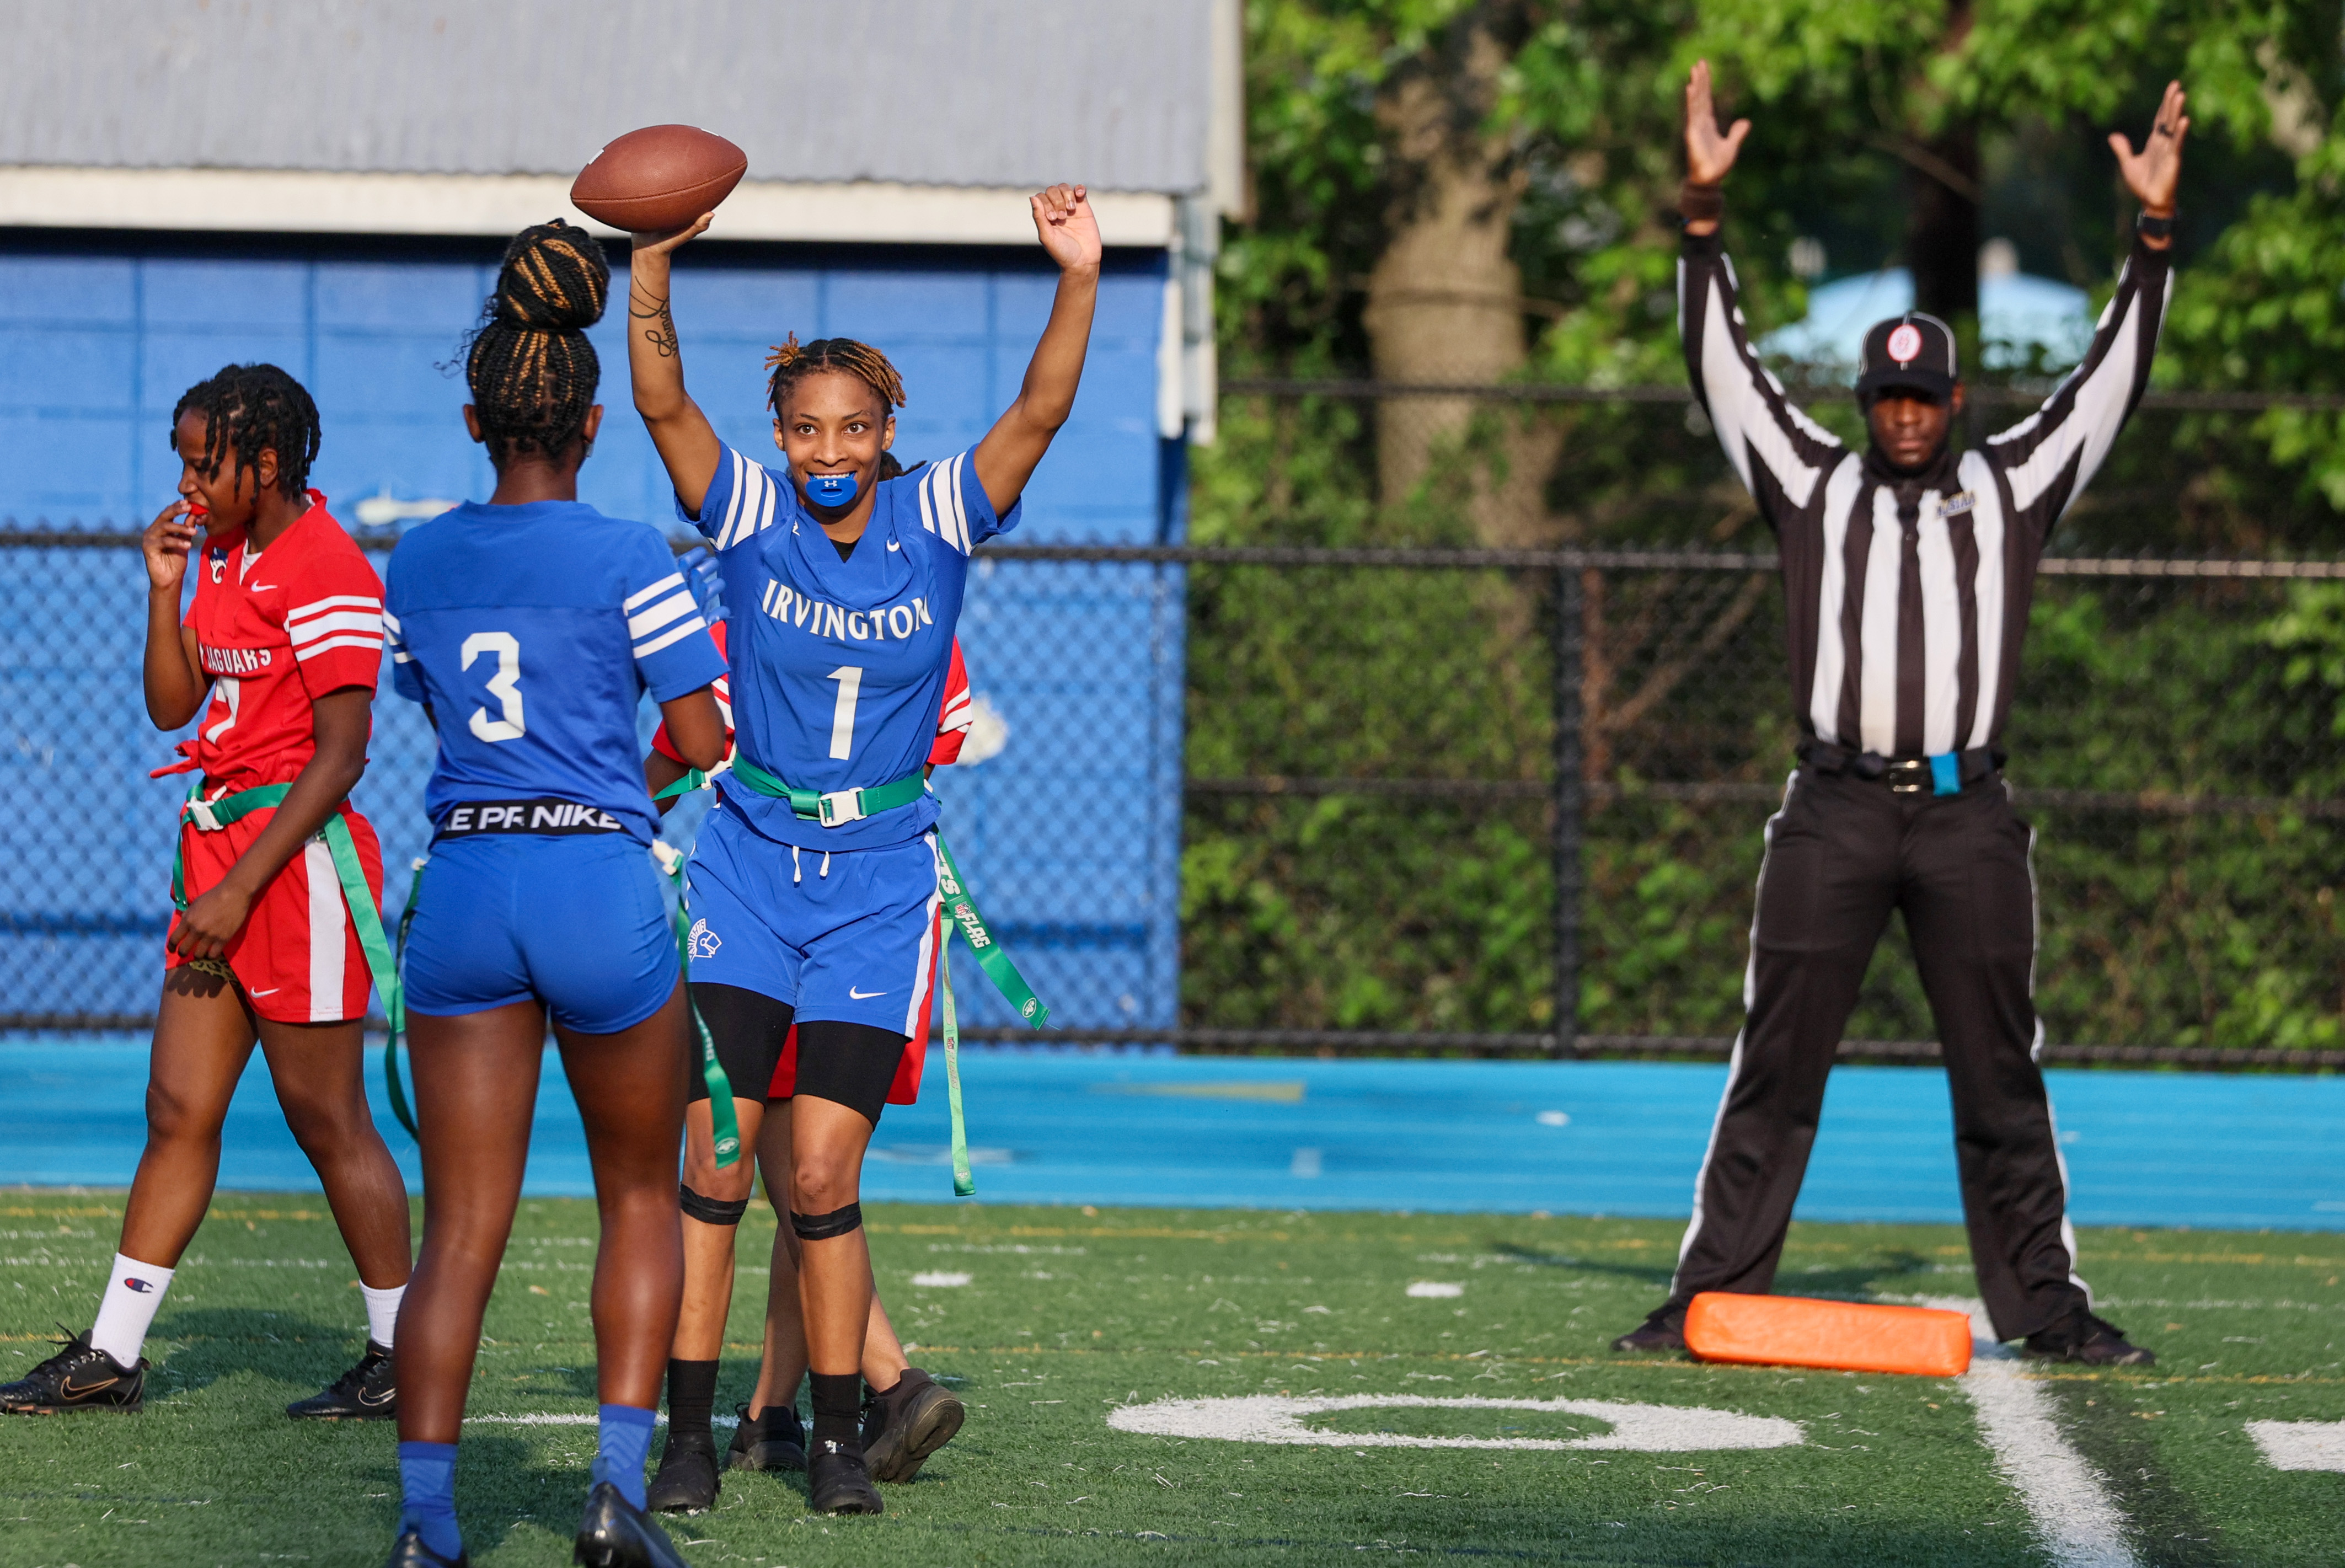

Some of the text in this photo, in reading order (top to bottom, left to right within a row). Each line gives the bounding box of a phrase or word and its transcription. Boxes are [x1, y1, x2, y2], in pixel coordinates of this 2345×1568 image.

[762, 577, 933, 641] IRVINGTON
[206, 645, 272, 674] JAGUARS
[461, 631, 526, 743] 3
[206, 676, 240, 745] 7
[827, 665, 863, 761] 1
[531, 804, 622, 830] NIKE
[954, 912, 991, 949] FLAG
